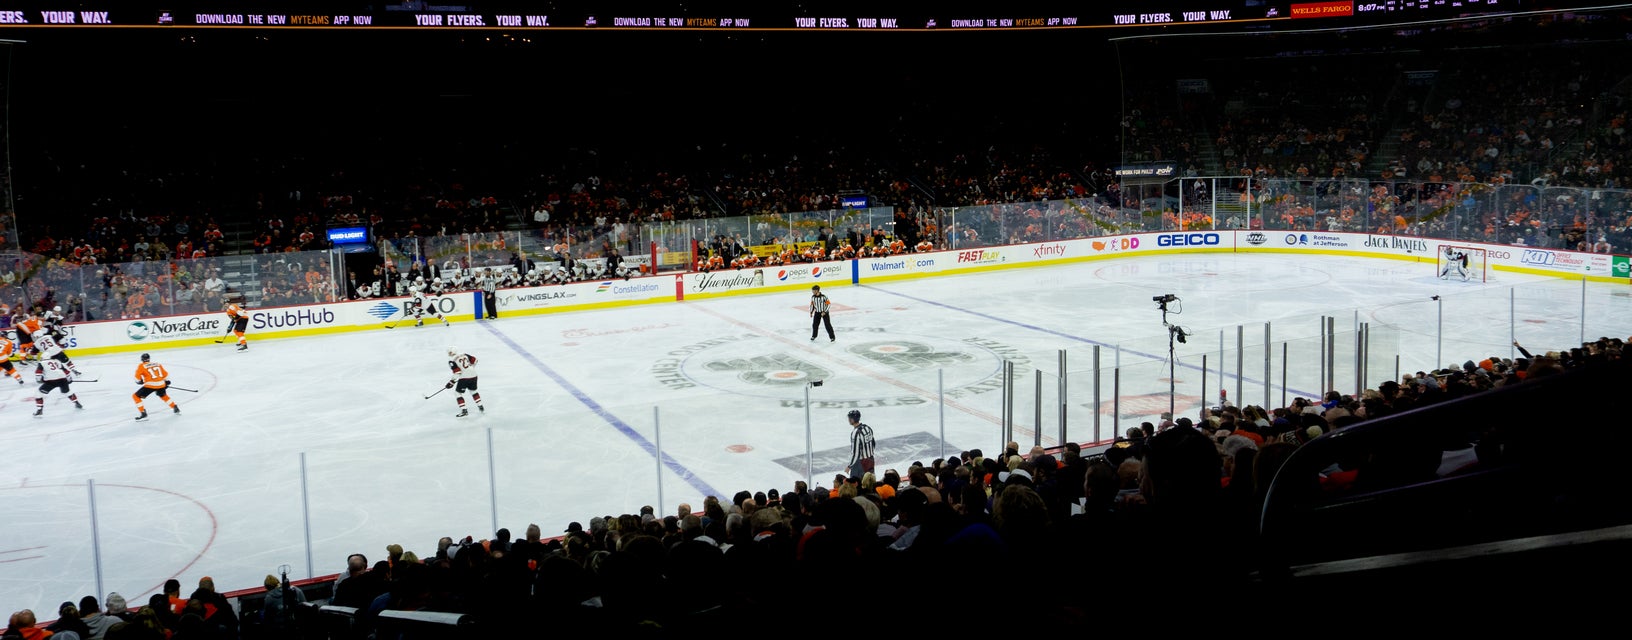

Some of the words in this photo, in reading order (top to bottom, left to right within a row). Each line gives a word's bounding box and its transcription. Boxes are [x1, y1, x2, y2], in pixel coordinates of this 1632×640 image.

[41, 11, 75, 23] YOUR
[81, 11, 111, 24] WAY.
[195, 14, 243, 24] DOWNLOAD
[248, 15, 263, 24] THE
[267, 15, 286, 25] NEW
[291, 15, 329, 25] MYTEAMS
[333, 15, 350, 25] APP
[353, 16, 372, 25] NOW
[415, 14, 442, 26] YOUR
[447, 15, 486, 26] FLYERS.
[496, 15, 522, 26] YOUR
[526, 16, 550, 26] WAY.
[614, 17, 651, 26] DOWNLOAD
[654, 18, 666, 26] THE
[669, 18, 683, 27] NEW
[687, 18, 717, 27] MYTEAMS
[720, 18, 733, 27] APP
[735, 19, 750, 27] NOW
[795, 18, 816, 27] YOUR
[819, 18, 850, 28] FLYERS.
[857, 18, 877, 28] YOUR
[880, 18, 899, 28] WAY.
[951, 19, 984, 28] DOWNLOAD
[986, 19, 997, 27] THE
[1000, 19, 1013, 27] NEW
[1016, 18, 1045, 26] MYTEAMS
[1047, 18, 1060, 26] APP
[1063, 17, 1078, 25] NOW
[1114, 15, 1136, 24] YOUR
[1140, 13, 1173, 23] FLYERS.
[1183, 12, 1206, 21] YOUR
[1210, 10, 1232, 20] WAY.
[1157, 233, 1220, 247] GEICO
[1364, 234, 1390, 248] JACK
[1033, 243, 1067, 259] xfinity
[822, 265, 842, 274] pepsi
[871, 260, 905, 271] Walmart
[916, 259, 935, 267] com
[789, 268, 809, 278] pepsi
[693, 273, 755, 293] Yuengling
[613, 284, 660, 295] Constellation
[252, 308, 335, 330] StubHub
[151, 317, 220, 335] NovaCare
[147, 366, 164, 379] 17
